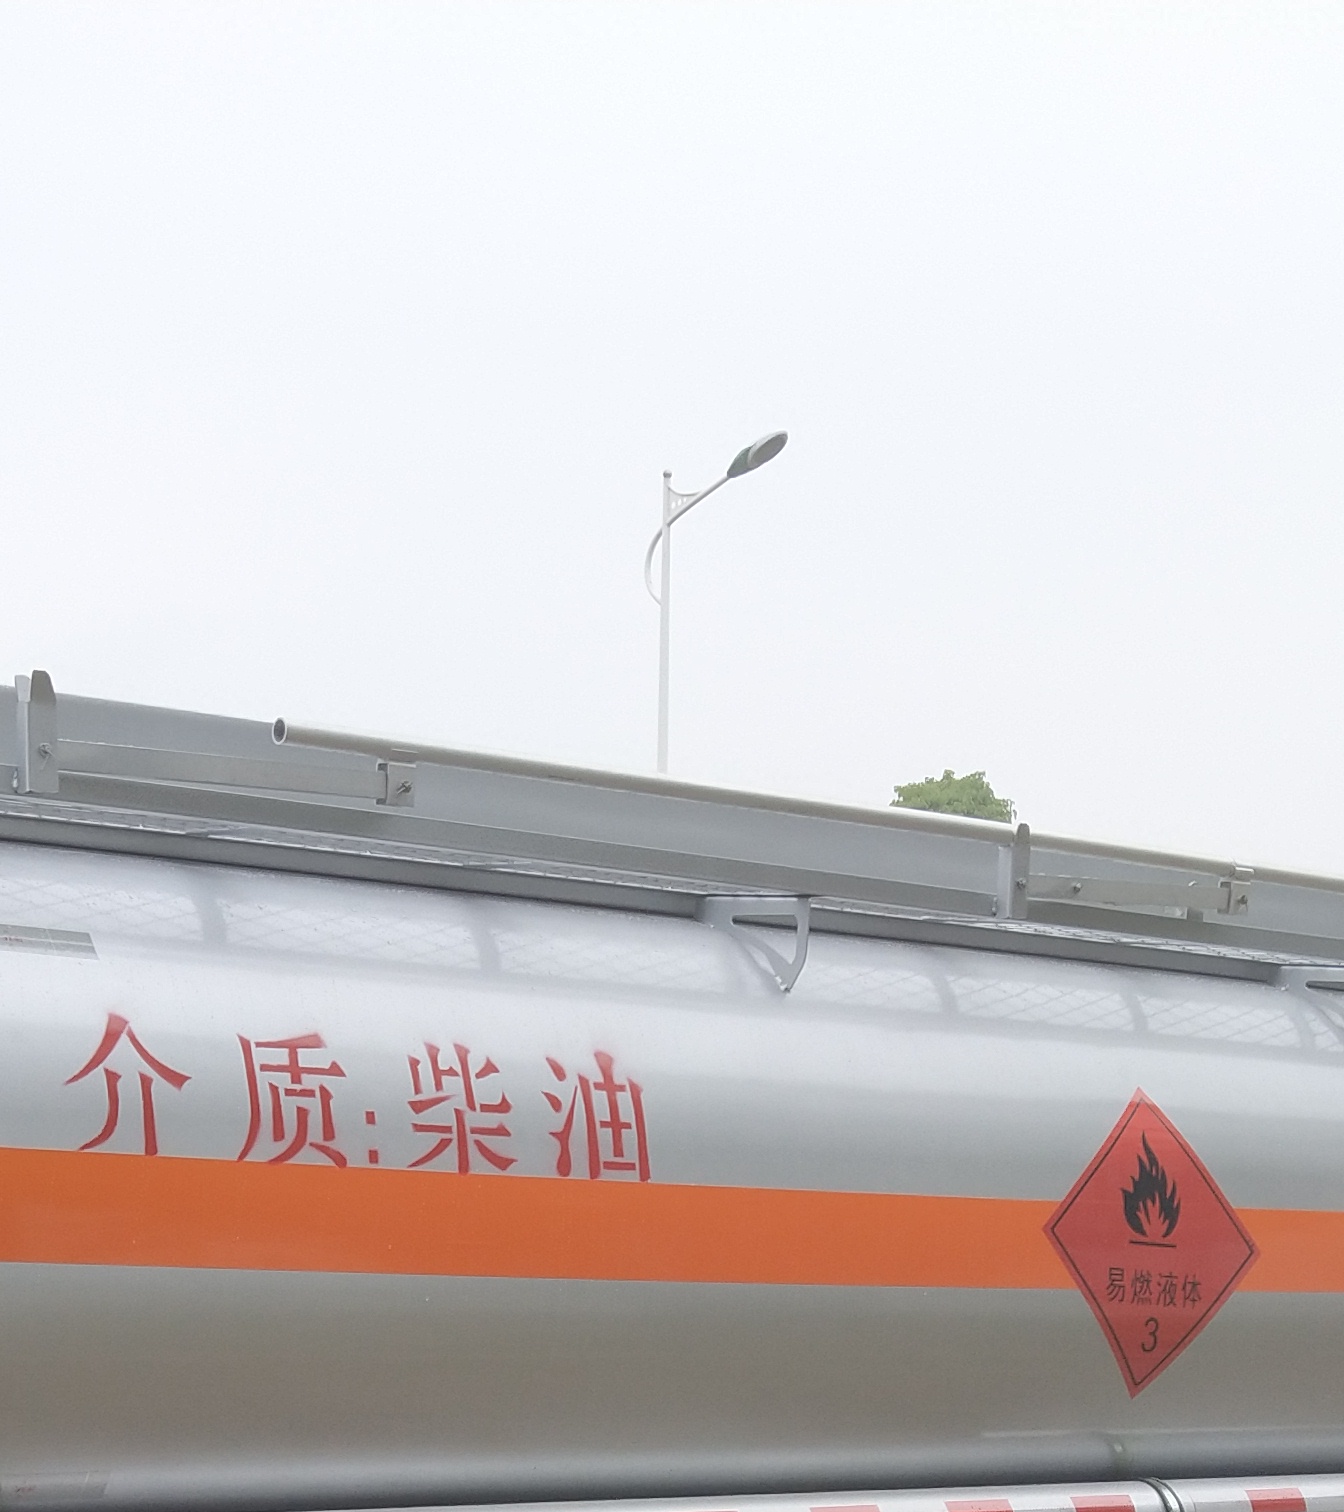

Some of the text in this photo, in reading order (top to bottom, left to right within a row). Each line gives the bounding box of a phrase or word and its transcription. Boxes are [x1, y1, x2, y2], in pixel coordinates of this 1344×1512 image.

[65, 1012, 652, 1183] 介质:柴油
[1106, 1267, 1202, 1309] 易燃液体
[1141, 1317, 1159, 1352] 3
